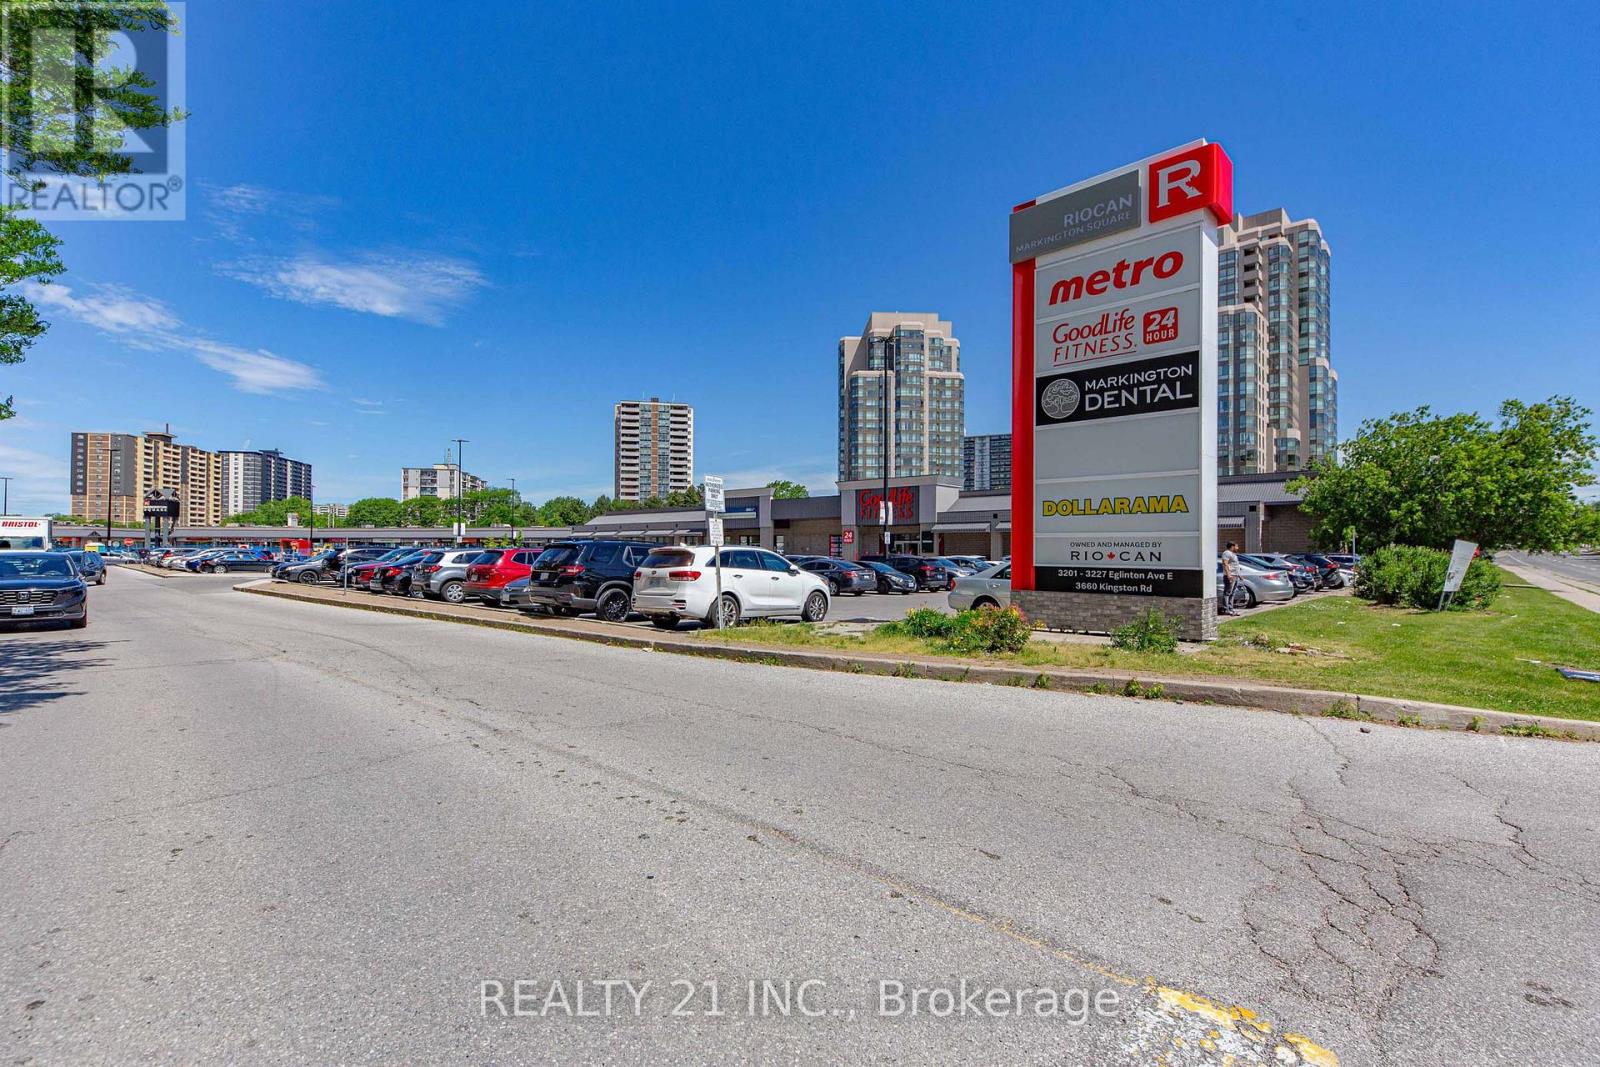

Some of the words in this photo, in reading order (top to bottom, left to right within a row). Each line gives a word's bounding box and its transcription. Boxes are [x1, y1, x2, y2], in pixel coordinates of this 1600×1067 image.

[1156, 159, 1202, 208] R
[1063, 193, 1133, 227] RIOCAN
[1015, 226, 1084, 254] MARKINGTON
[1087, 211, 1131, 231] SQUARE
[1048, 251, 1183, 305] metro
[1052, 308, 1135, 344] GoodLife
[1147, 310, 1176, 332] 24
[1146, 328, 1175, 343] HOUR
[1085, 364, 1192, 391] MARKINGTON
[1085, 381, 1193, 411] DENTAL
[1043, 495, 1189, 516] DOLLARAMA
[1058, 569, 1077, 577] 3201
[1085, 570, 1106, 578] 3227
[1108, 570, 1145, 580] Eglinton
[1147, 572, 1165, 580] Ave
[1167, 572, 1173, 580] E
[1075, 582, 1097, 590] 3660
[1099, 582, 1138, 593] Kingston
[1140, 584, 1152, 593] Rd
